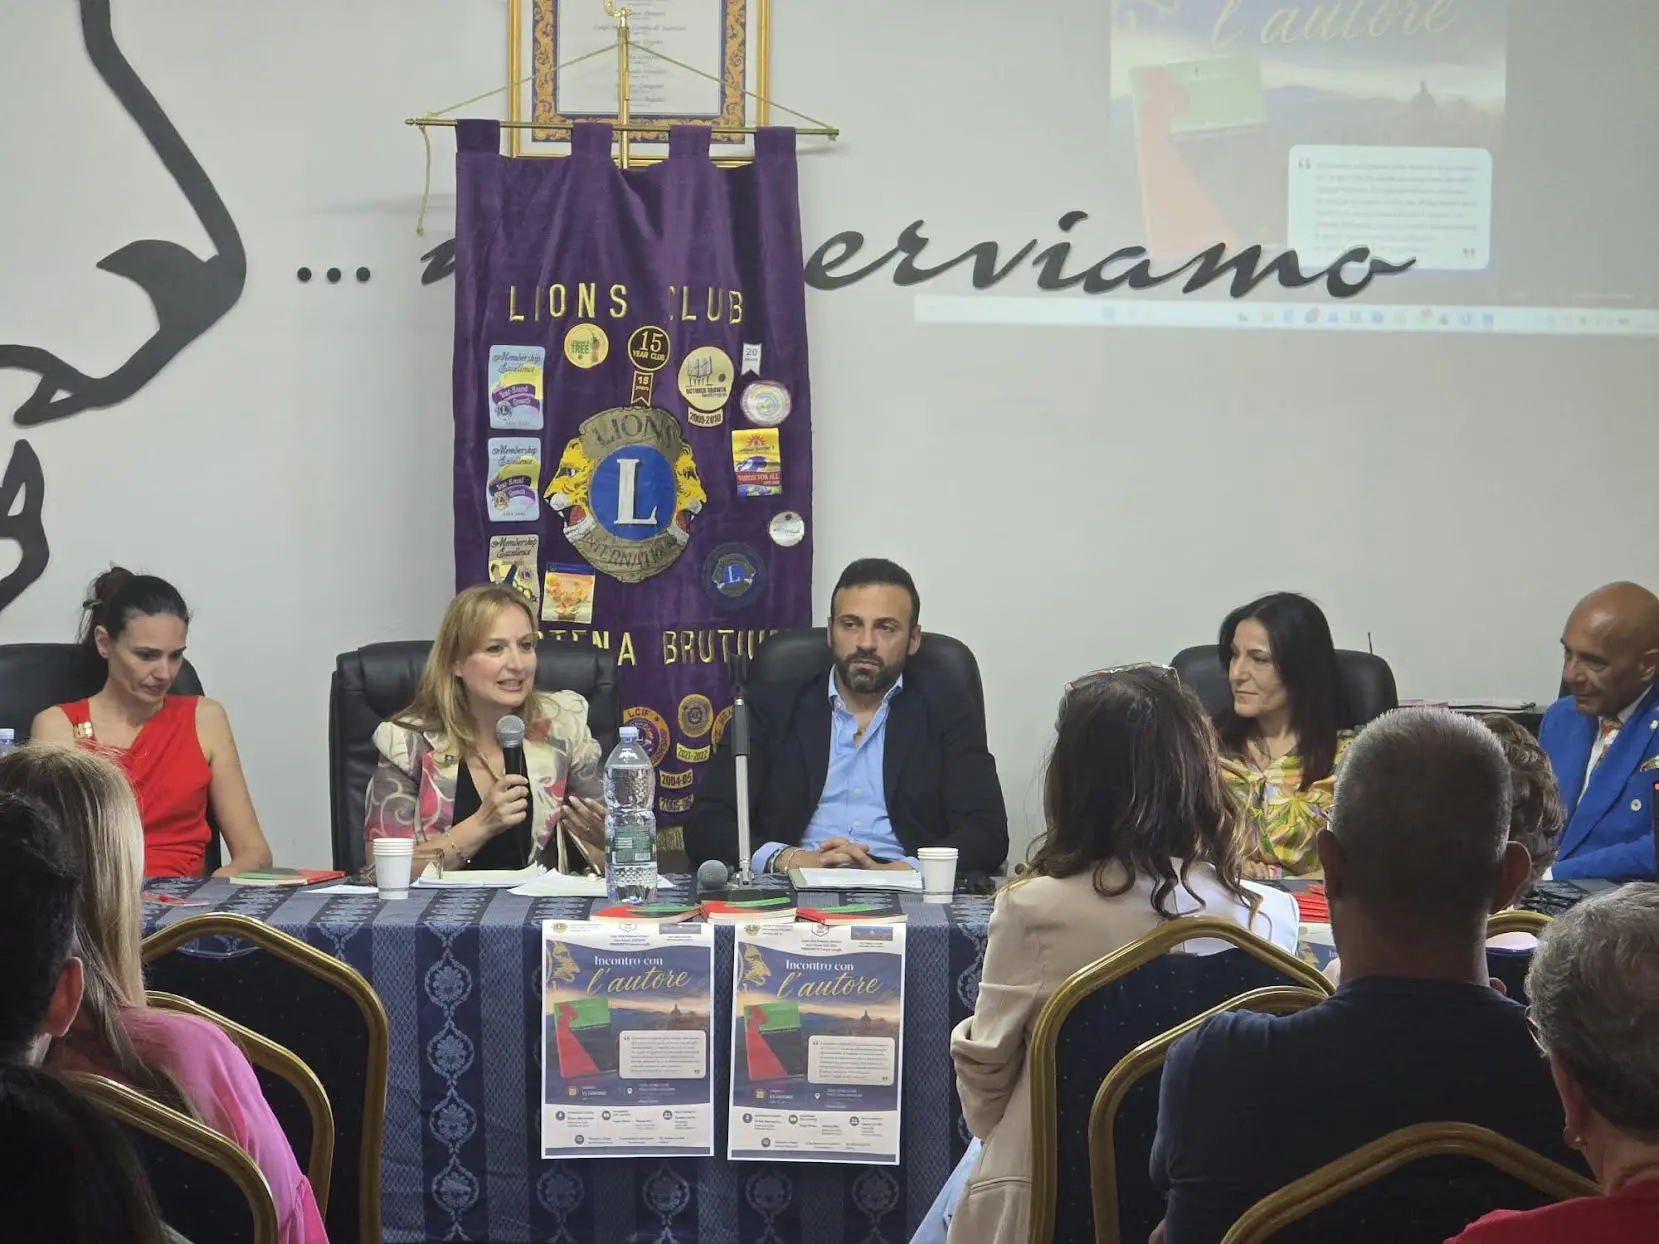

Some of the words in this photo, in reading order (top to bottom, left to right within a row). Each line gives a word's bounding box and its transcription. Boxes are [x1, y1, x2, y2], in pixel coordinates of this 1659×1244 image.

[1211, 0, 1457, 48] lautore
[804, 210, 1417, 298] erviamo
[509, 282, 628, 321] LIONS
[639, 331, 664, 352] 15
[571, 344, 589, 354] TREE
[632, 350, 648, 359] YEAR
[650, 353, 666, 362] CLUB
[745, 347, 758, 356] 20
[637, 375, 650, 385] 15
[613, 458, 658, 525] L
[627, 707, 650, 718] LCIF
[661, 772, 692, 786] 2004-05
[594, 955, 641, 966] Incontro
[643, 957, 664, 966] con
[786, 959, 832, 970] Incontro
[834, 961, 854, 971] con
[586, 966, 692, 996] l'autore
[777, 971, 882, 998] l'autore
